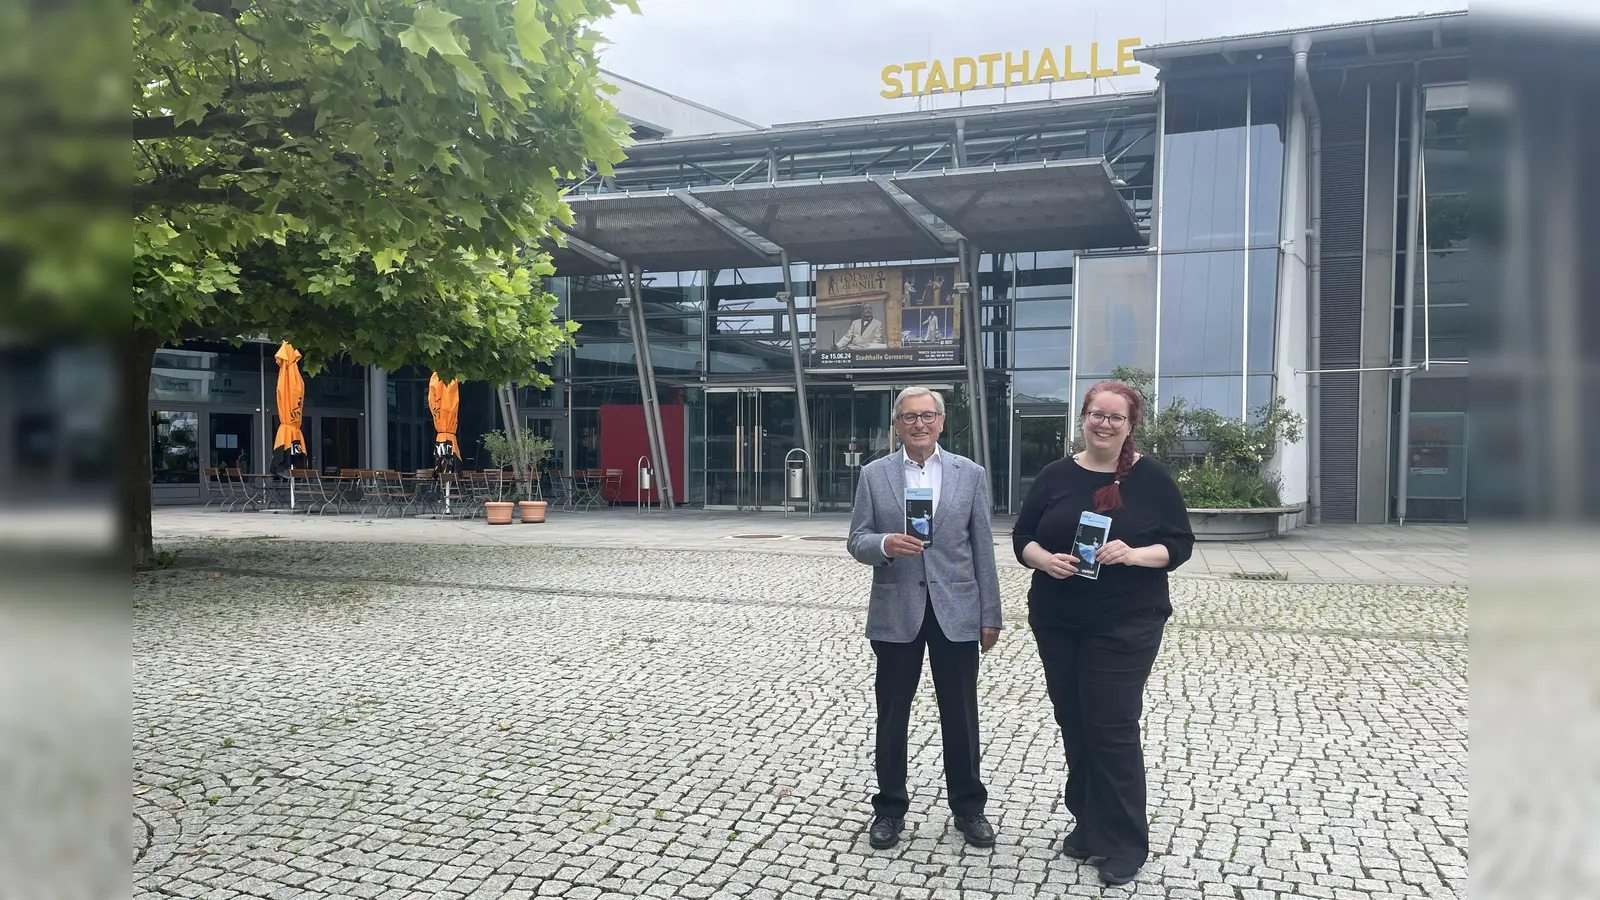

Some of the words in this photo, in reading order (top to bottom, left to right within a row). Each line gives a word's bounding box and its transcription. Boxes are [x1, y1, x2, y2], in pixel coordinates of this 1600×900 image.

[880, 37, 1141, 99] STADTHALLE
[838, 272, 861, 283] TOD
[858, 280, 876, 291] NIL
[830, 352, 851, 360] 15.06.24
[884, 353, 913, 361] Germering
